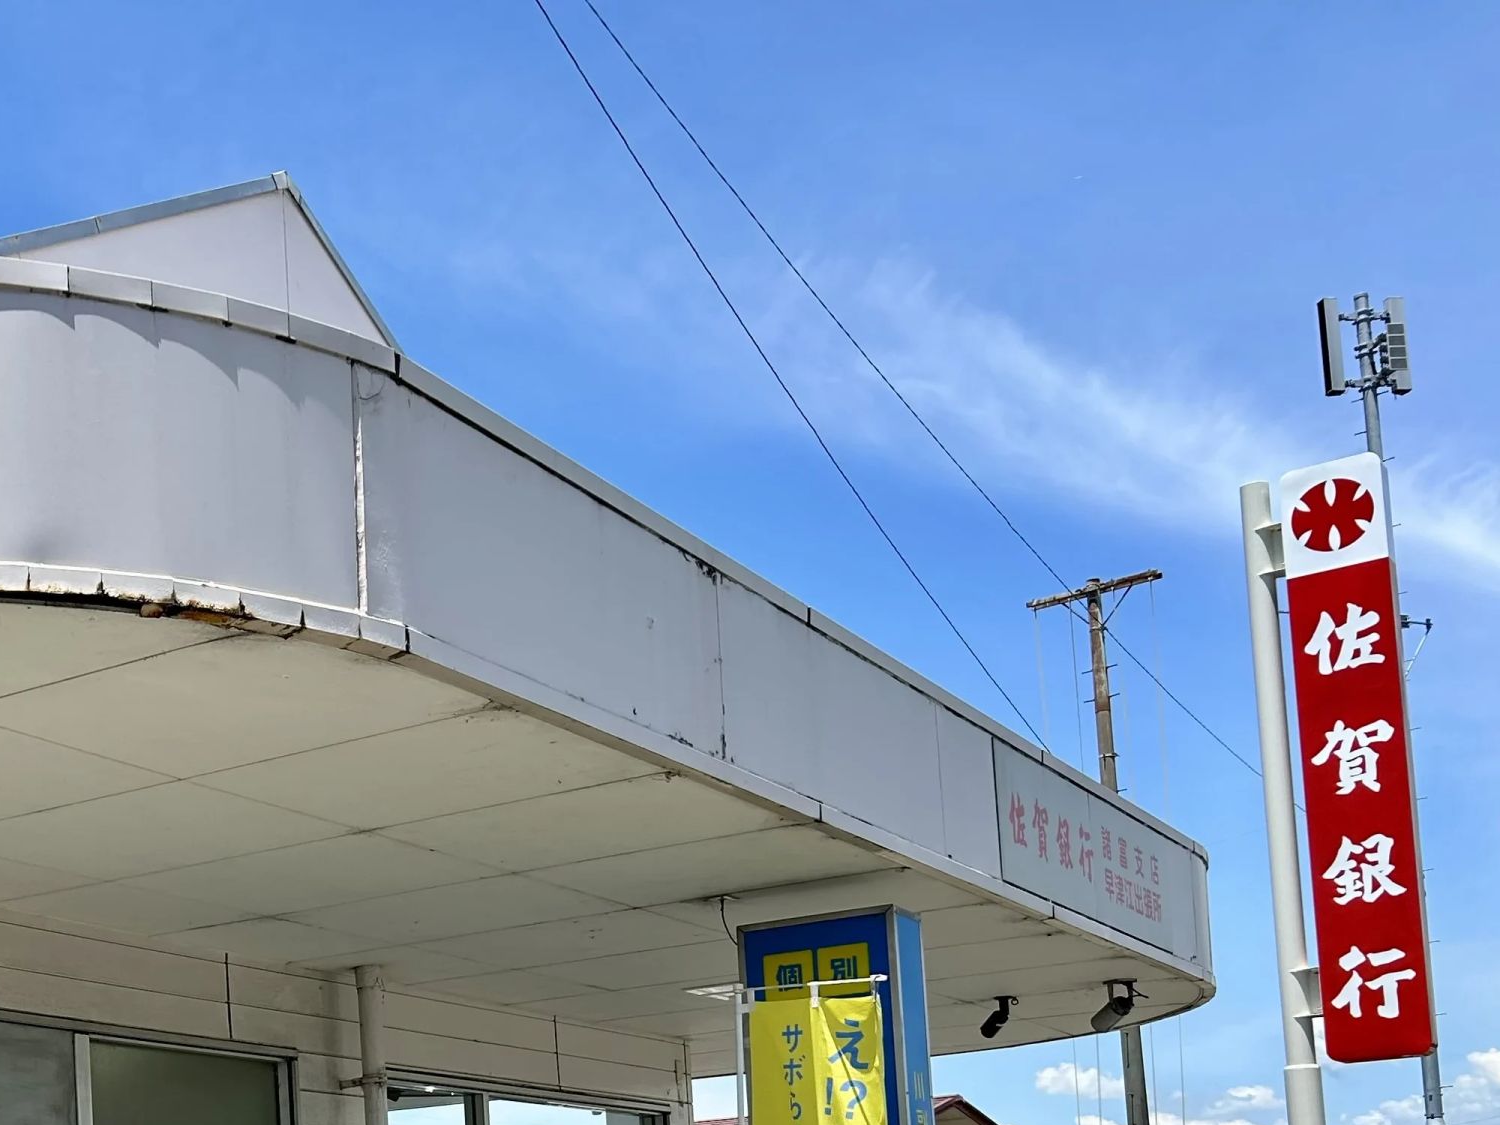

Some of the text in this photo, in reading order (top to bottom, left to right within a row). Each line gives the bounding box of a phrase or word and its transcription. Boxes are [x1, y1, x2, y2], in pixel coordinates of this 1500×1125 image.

[1009, 792, 1094, 883] 佐賀銀行
[1305, 602, 1417, 1019] 佐賀銀行
